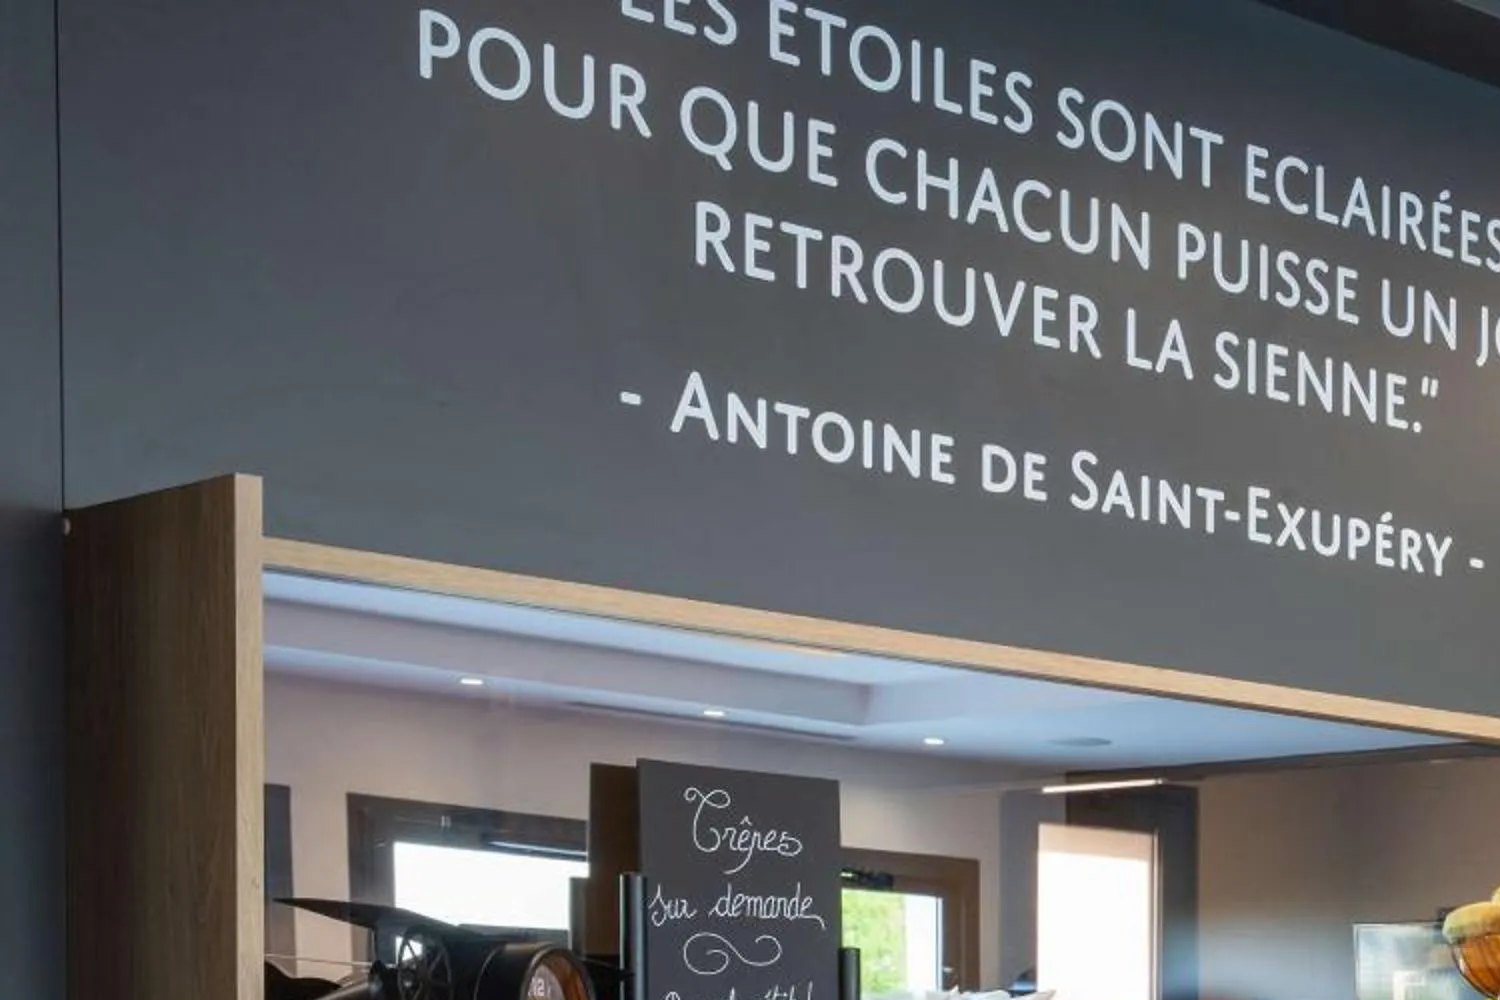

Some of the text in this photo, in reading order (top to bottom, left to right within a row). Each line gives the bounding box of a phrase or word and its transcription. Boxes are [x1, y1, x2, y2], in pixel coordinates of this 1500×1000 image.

[769, 0, 1033, 134] ETOILES
[1055, 87, 1225, 188] SONT
[419, 8, 653, 139] POUR
[679, 86, 839, 188] QUE
[865, 137, 1150, 271] CHACUN
[1177, 222, 1360, 325] PUISSE
[1381, 278, 1457, 351] UN
[695, 200, 1439, 433] RETROUVER LA SIENNE."
[669, 370, 956, 485] ANTOINE
[981, 443, 1048, 502] DE
[683, 787, 803, 875] Crêpes
[708, 881, 827, 931] demande
